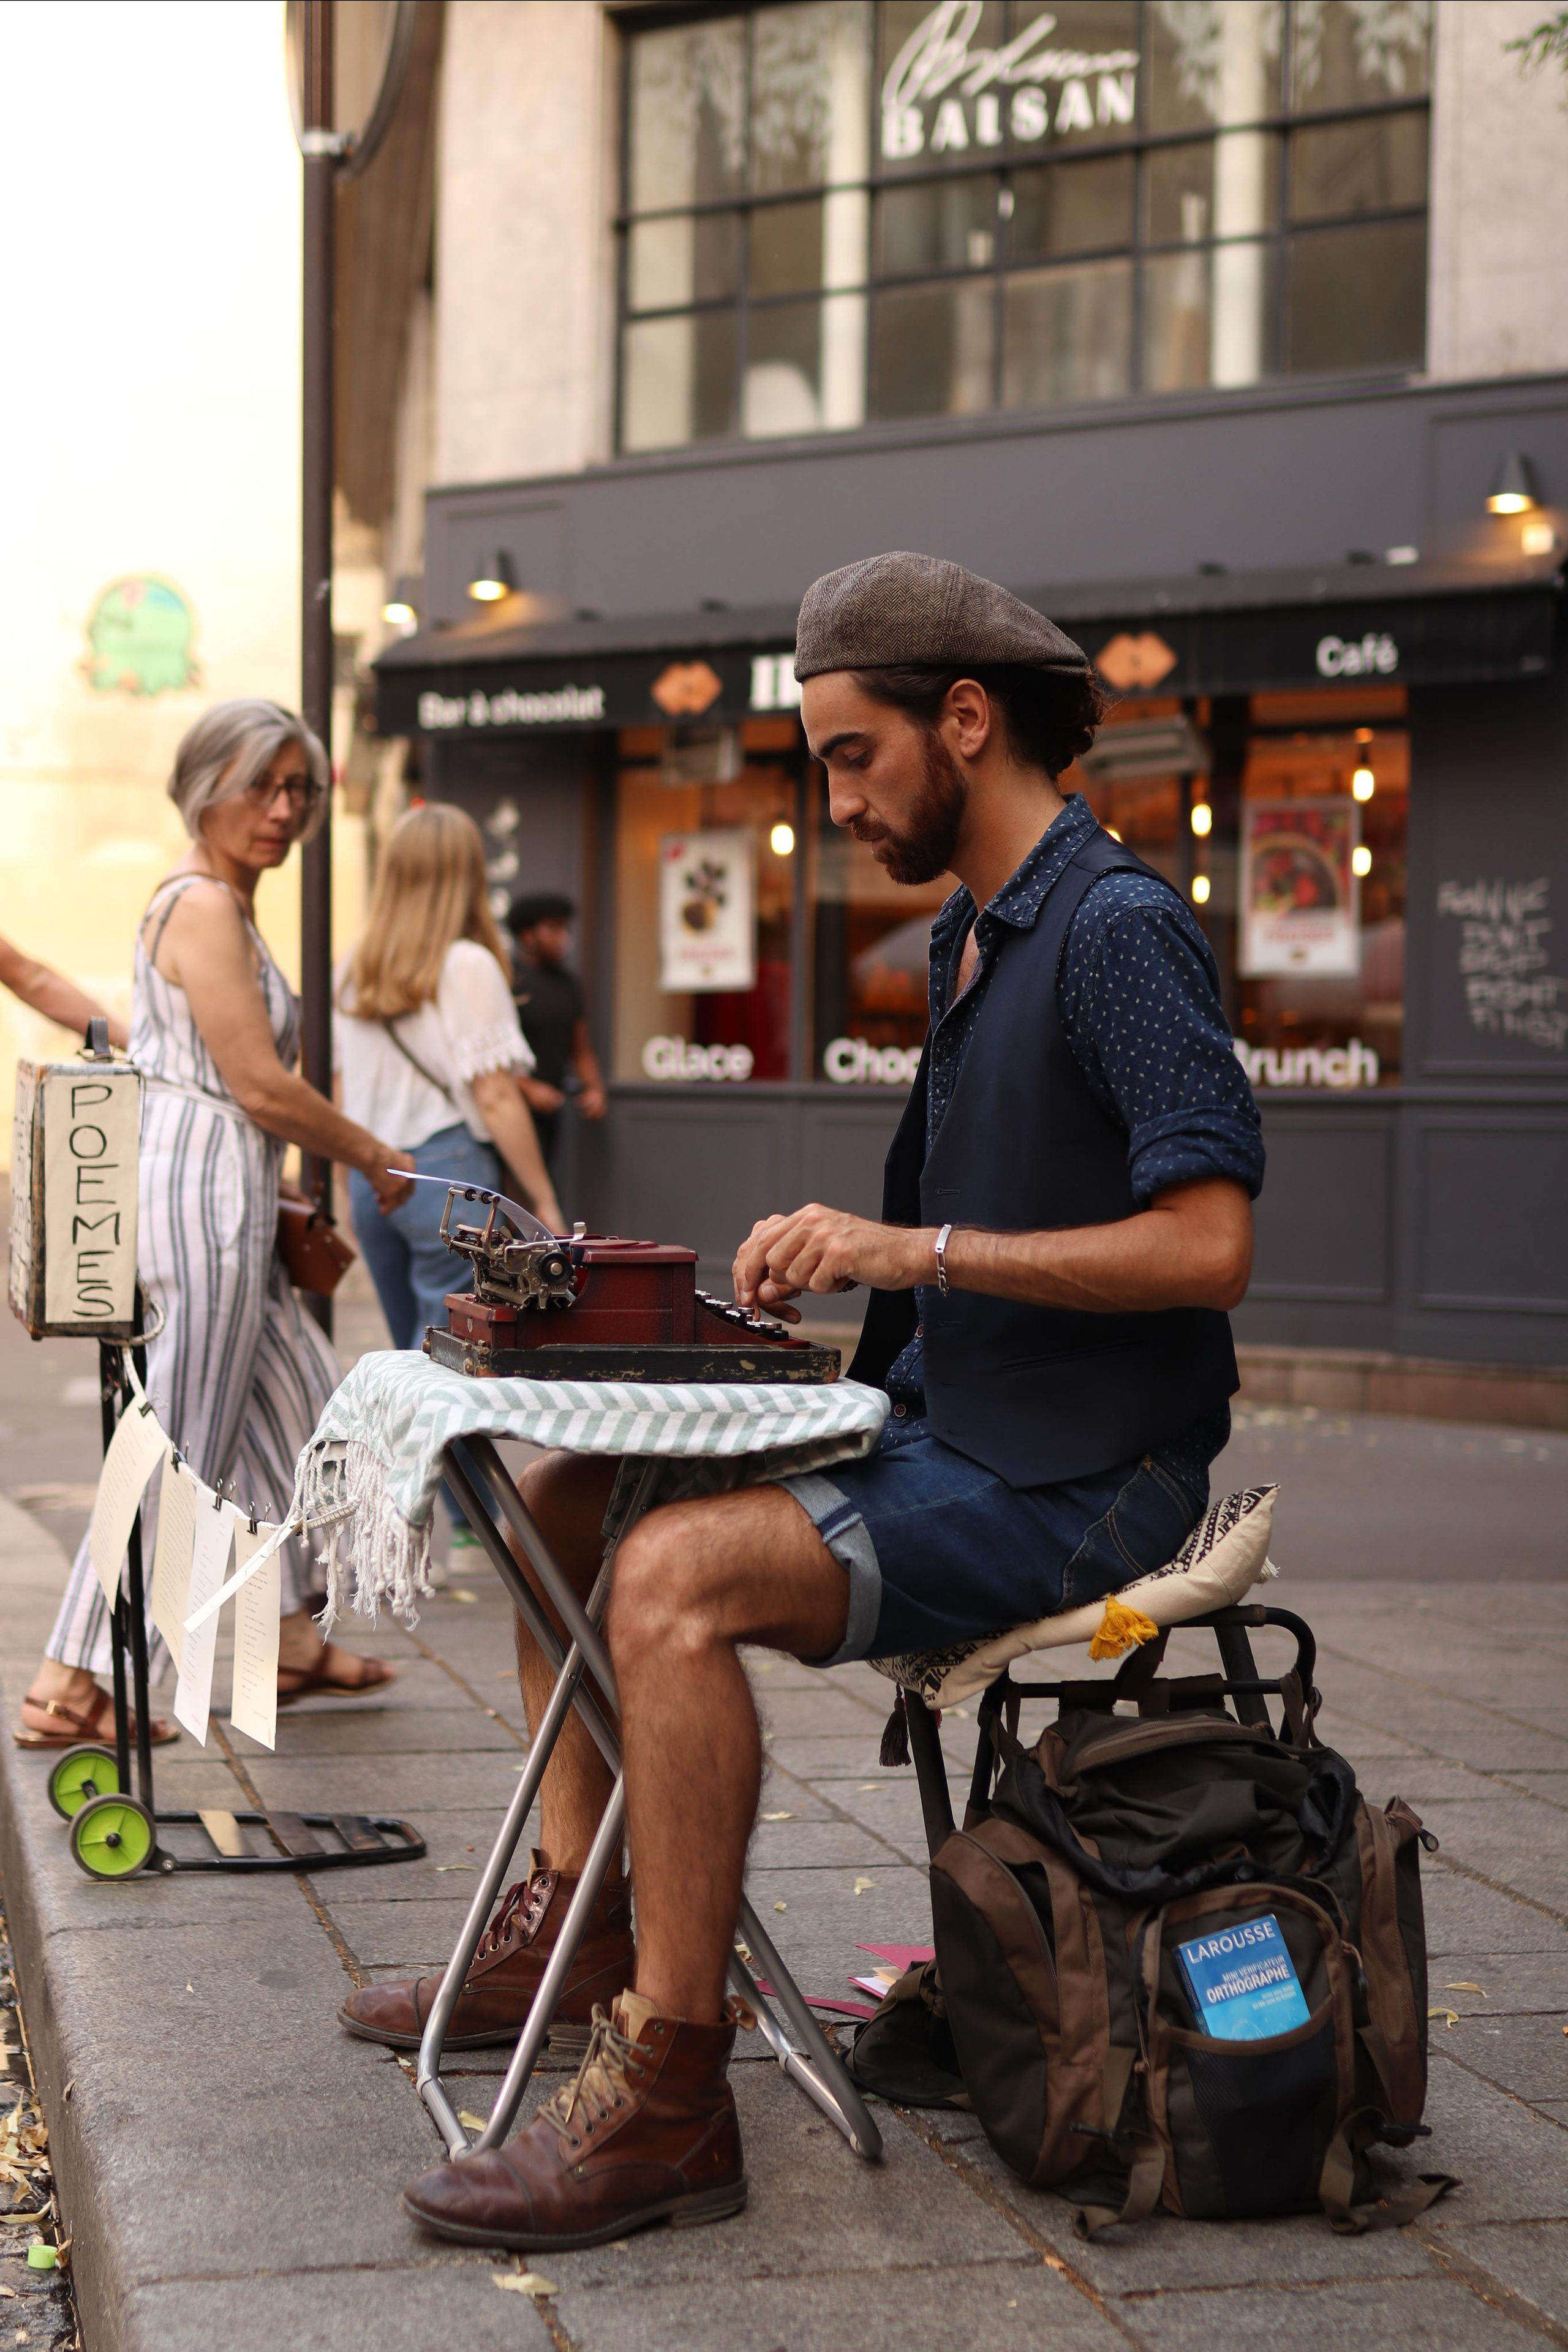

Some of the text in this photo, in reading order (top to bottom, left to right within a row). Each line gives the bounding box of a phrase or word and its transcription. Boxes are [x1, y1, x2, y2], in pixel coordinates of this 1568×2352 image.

[1316, 632, 1398, 676] Café
[418, 683, 605, 729] Bar à chocolat
[643, 1035, 754, 1082] Glace
[69, 1084, 121, 1317] POEMES
[1186, 1921, 1276, 1964] LAROUSSE
[1206, 1964, 1291, 2003] ORTHOGRAPHE
[1222, 1971, 1239, 1984] MINI
